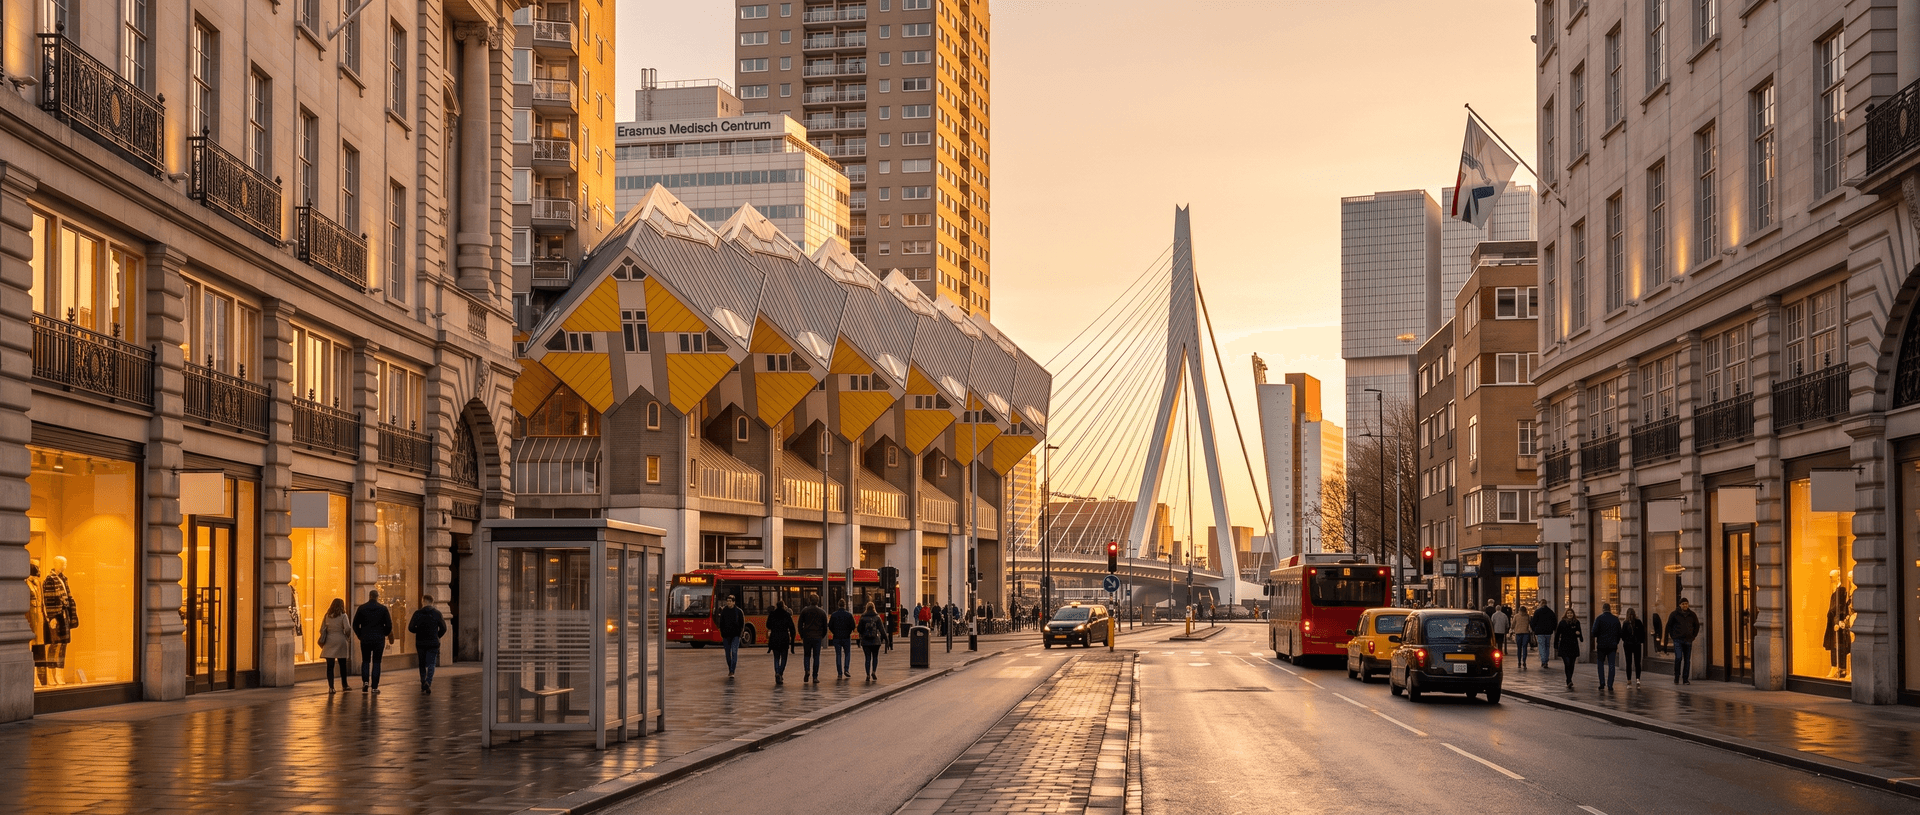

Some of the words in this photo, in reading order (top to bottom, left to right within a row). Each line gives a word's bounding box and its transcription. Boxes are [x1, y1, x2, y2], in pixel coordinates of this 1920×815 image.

[617, 125, 666, 137] Erasmus
[669, 121, 718, 135] Medisch
[721, 120, 771, 132] Centrum
